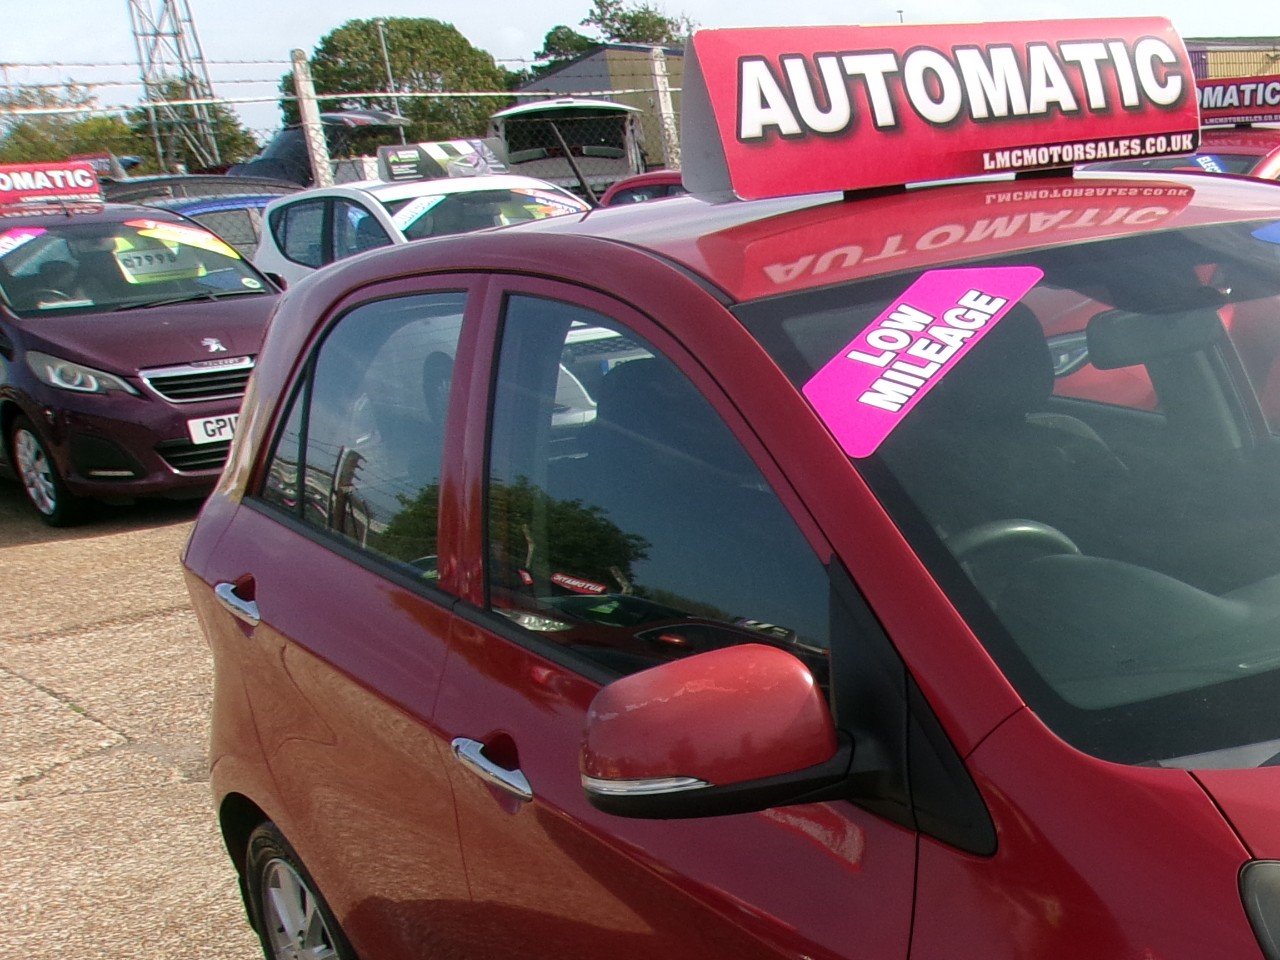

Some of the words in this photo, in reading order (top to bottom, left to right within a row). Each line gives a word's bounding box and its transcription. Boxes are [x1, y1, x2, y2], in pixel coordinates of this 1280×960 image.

[738, 36, 1185, 140] AUTOMATIC
[983, 133, 1194, 171] LMCMOTORSALES.CO.UK
[845, 302, 937, 368] LOW
[857, 288, 1009, 414] MILEAGE
[202, 416, 239, 438] GP1
